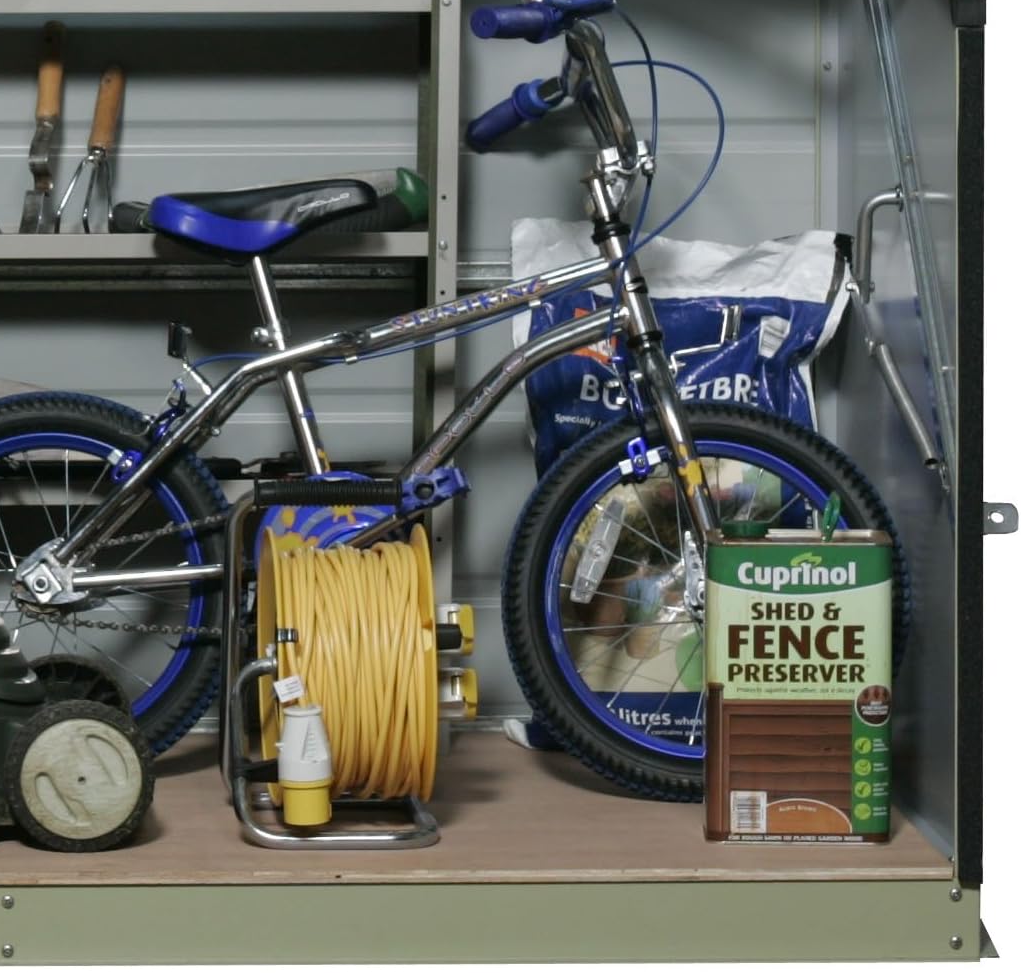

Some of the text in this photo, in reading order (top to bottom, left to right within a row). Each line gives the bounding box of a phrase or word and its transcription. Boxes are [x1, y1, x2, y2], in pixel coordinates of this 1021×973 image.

[737, 561, 857, 592] Cuprinol
[751, 602, 842, 621] SHED &
[727, 624, 866, 660] FENCE
[727, 663, 866, 683] PRESERVER
[618, 707, 672, 726] litres
